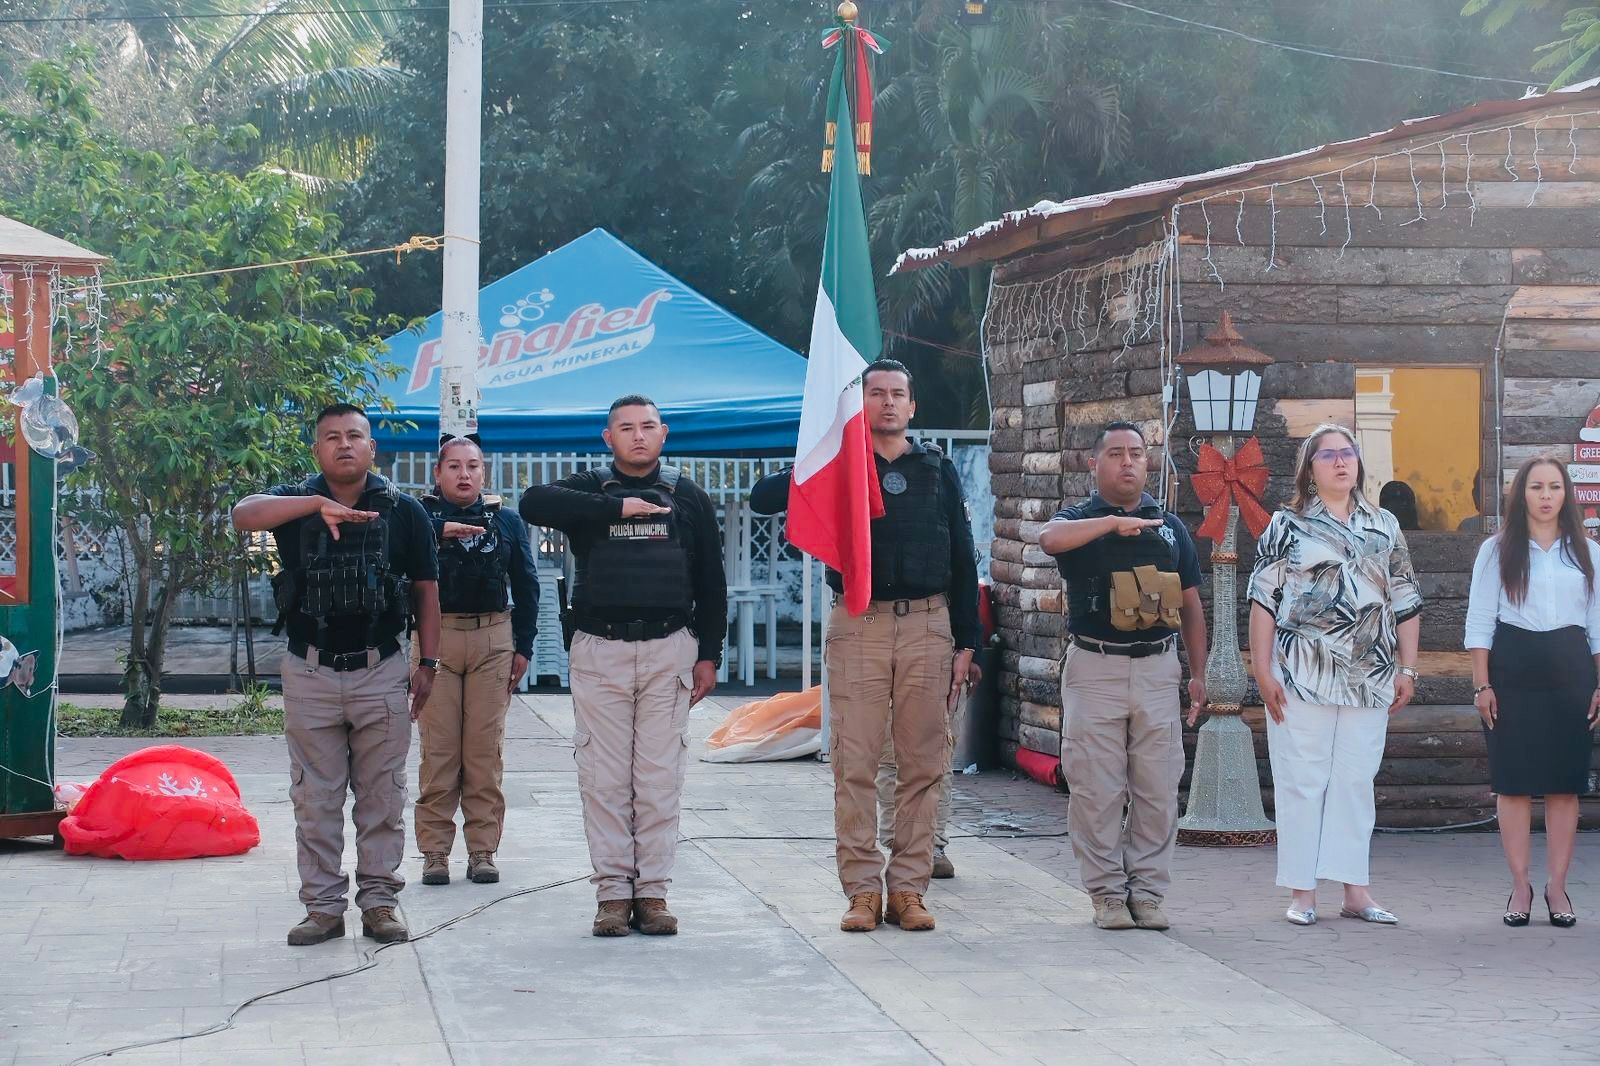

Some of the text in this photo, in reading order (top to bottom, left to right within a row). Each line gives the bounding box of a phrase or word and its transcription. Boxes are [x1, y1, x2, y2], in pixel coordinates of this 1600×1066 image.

[489, 340, 642, 385] AGUA MINERAL
[1578, 490, 1600, 502] WOR
[609, 523, 668, 537] POLICÍA MUNICIPAL
